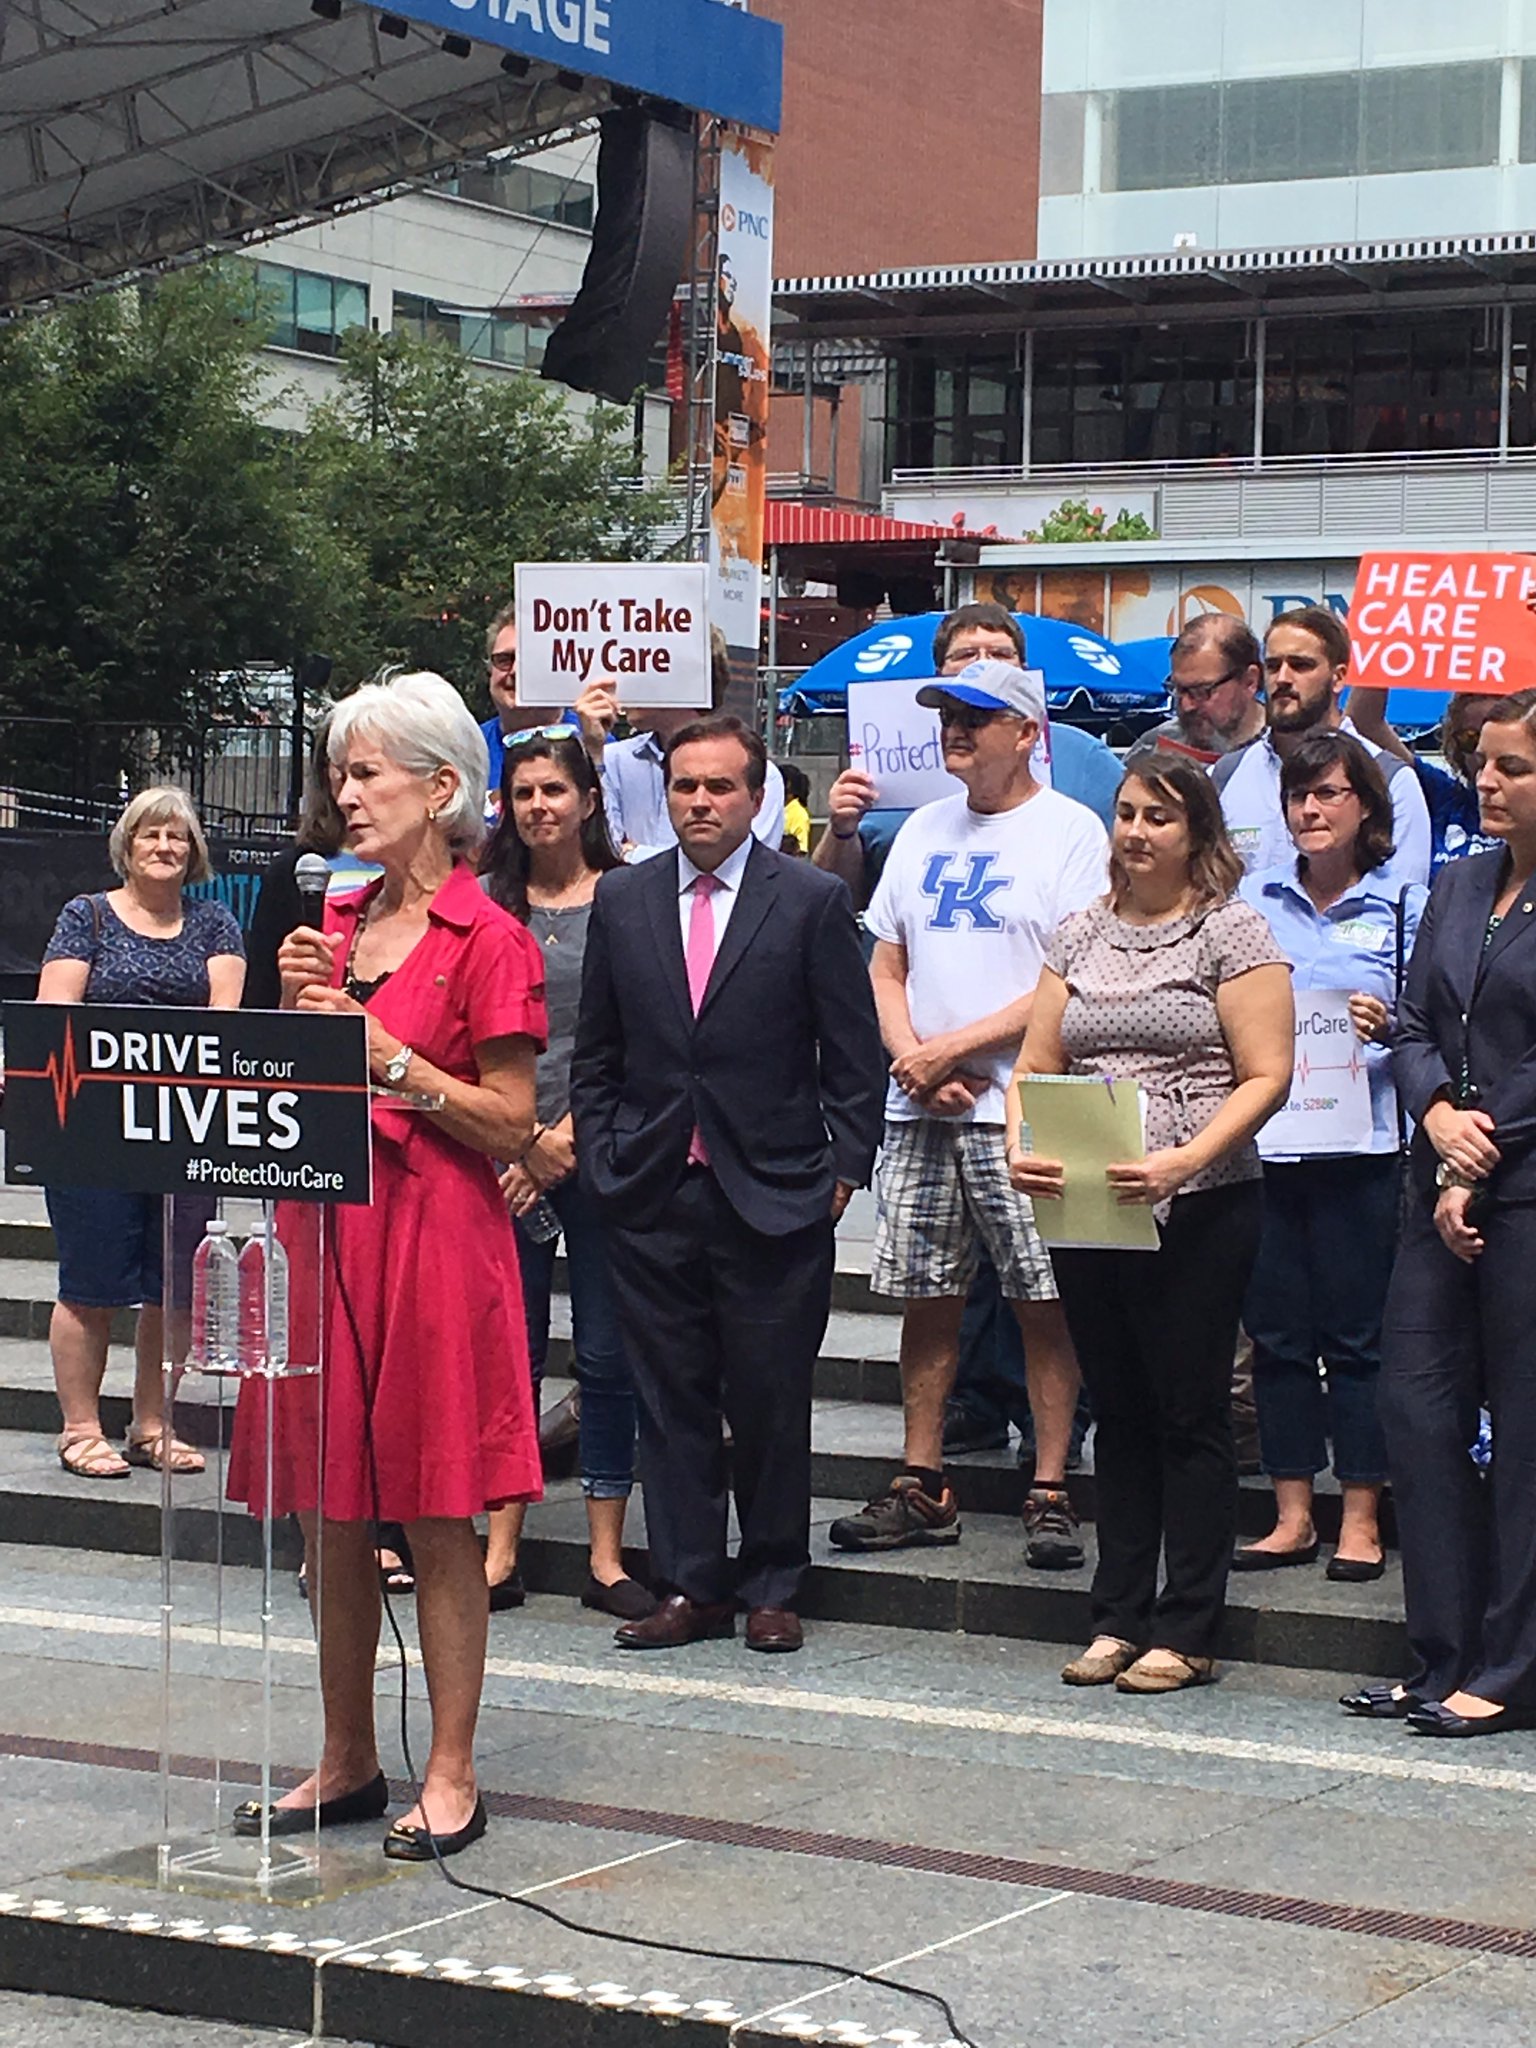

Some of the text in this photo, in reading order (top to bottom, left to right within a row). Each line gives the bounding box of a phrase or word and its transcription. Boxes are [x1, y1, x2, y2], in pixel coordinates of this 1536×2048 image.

[449, 0, 610, 54] AGE
[738, 210, 769, 240] PNC
[533, 598, 692, 633] Don't Take
[1357, 601, 1481, 639] CARE
[551, 639, 671, 682] My Care
[1351, 639, 1506, 683] VOTER
[918, 851, 1014, 934] UK
[90, 1030, 295, 1079] DRIVE for our
[123, 1084, 301, 1150] LIVES
[186, 1159, 344, 1190] #ProtectOurCare
